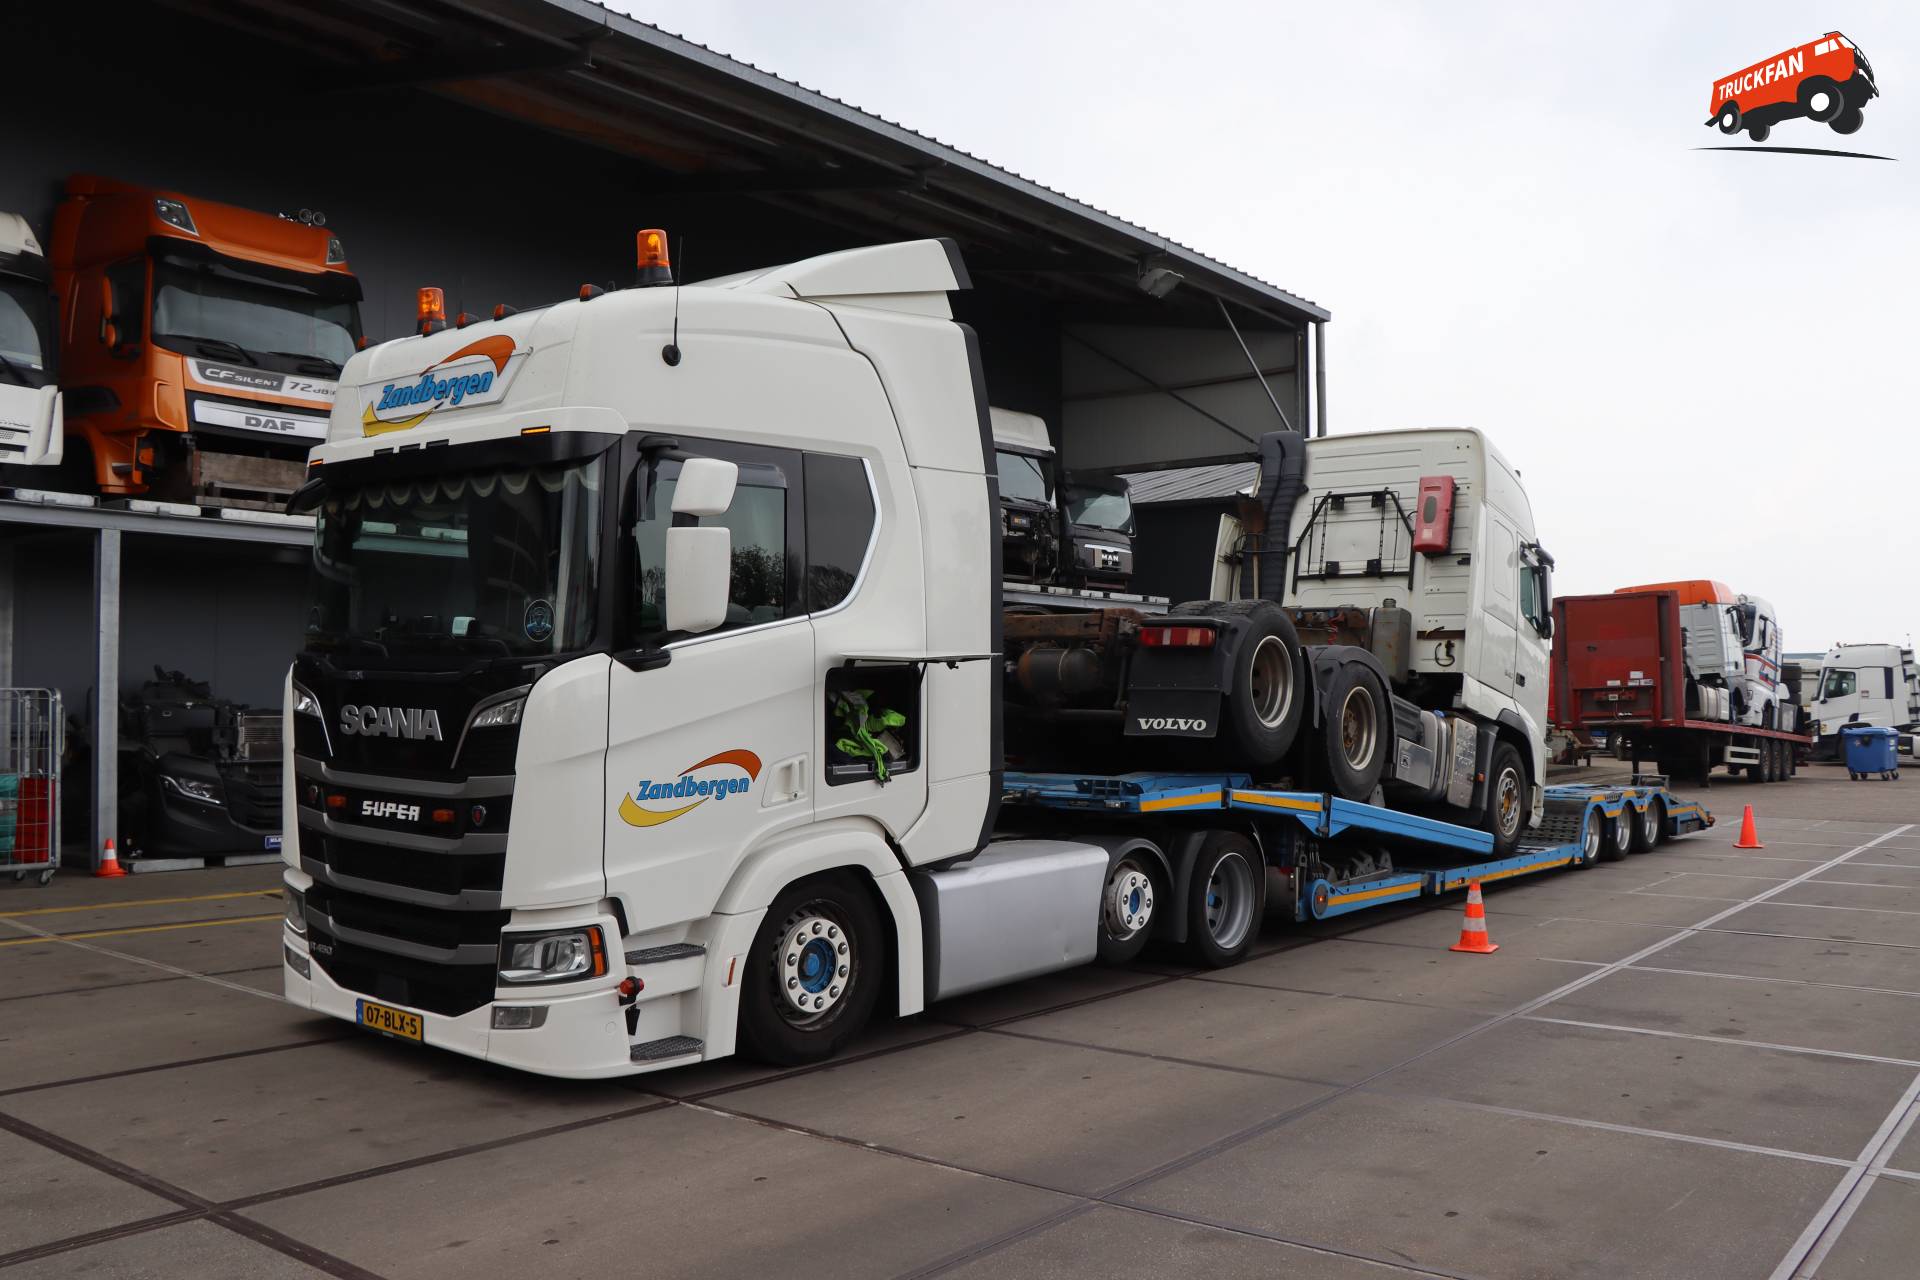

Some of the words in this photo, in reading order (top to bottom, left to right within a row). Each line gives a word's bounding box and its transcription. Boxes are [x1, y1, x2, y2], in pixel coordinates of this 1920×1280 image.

[205, 368, 235, 379] CF
[234, 375, 279, 387] SILENT
[376, 370, 494, 411] Zandbergen
[244, 415, 295, 432] DAF
[1101, 553, 1119, 562] MAN
[340, 704, 443, 741] SCANIA
[1137, 718, 1207, 731] VOLVO
[636, 776, 750, 801] Zandbergen
[361, 800, 421, 822] SUPER
[366, 1006, 418, 1035] 07-BLX-5
